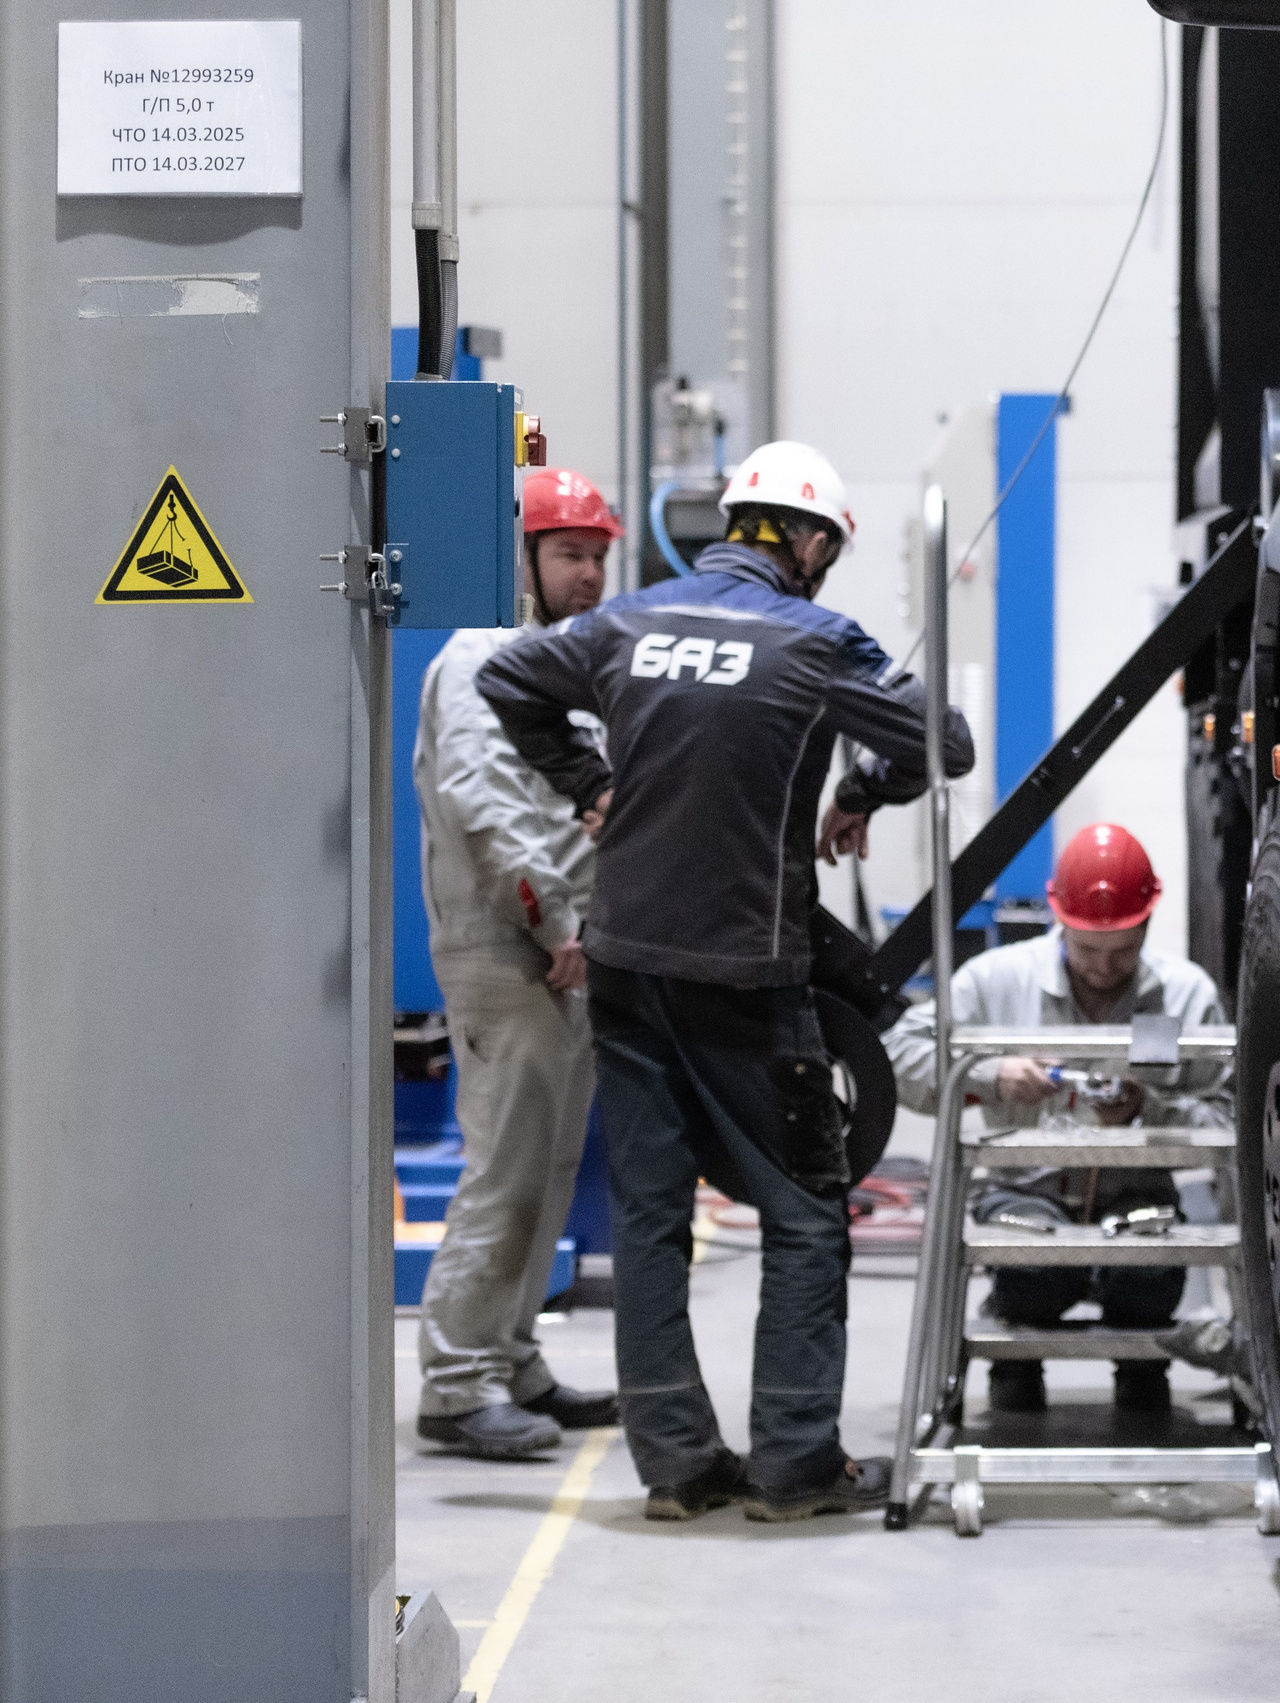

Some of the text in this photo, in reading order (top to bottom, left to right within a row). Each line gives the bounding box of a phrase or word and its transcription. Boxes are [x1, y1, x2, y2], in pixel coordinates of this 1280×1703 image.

[104, 69, 254, 87] Кран №12993259
[142, 97, 214, 115] Г/П 5,0 т
[112, 127, 245, 142] ЧТО 14.03.2025
[112, 157, 246, 172] ПТО 14.03.2027
[630, 633, 753, 685] БАЗ
